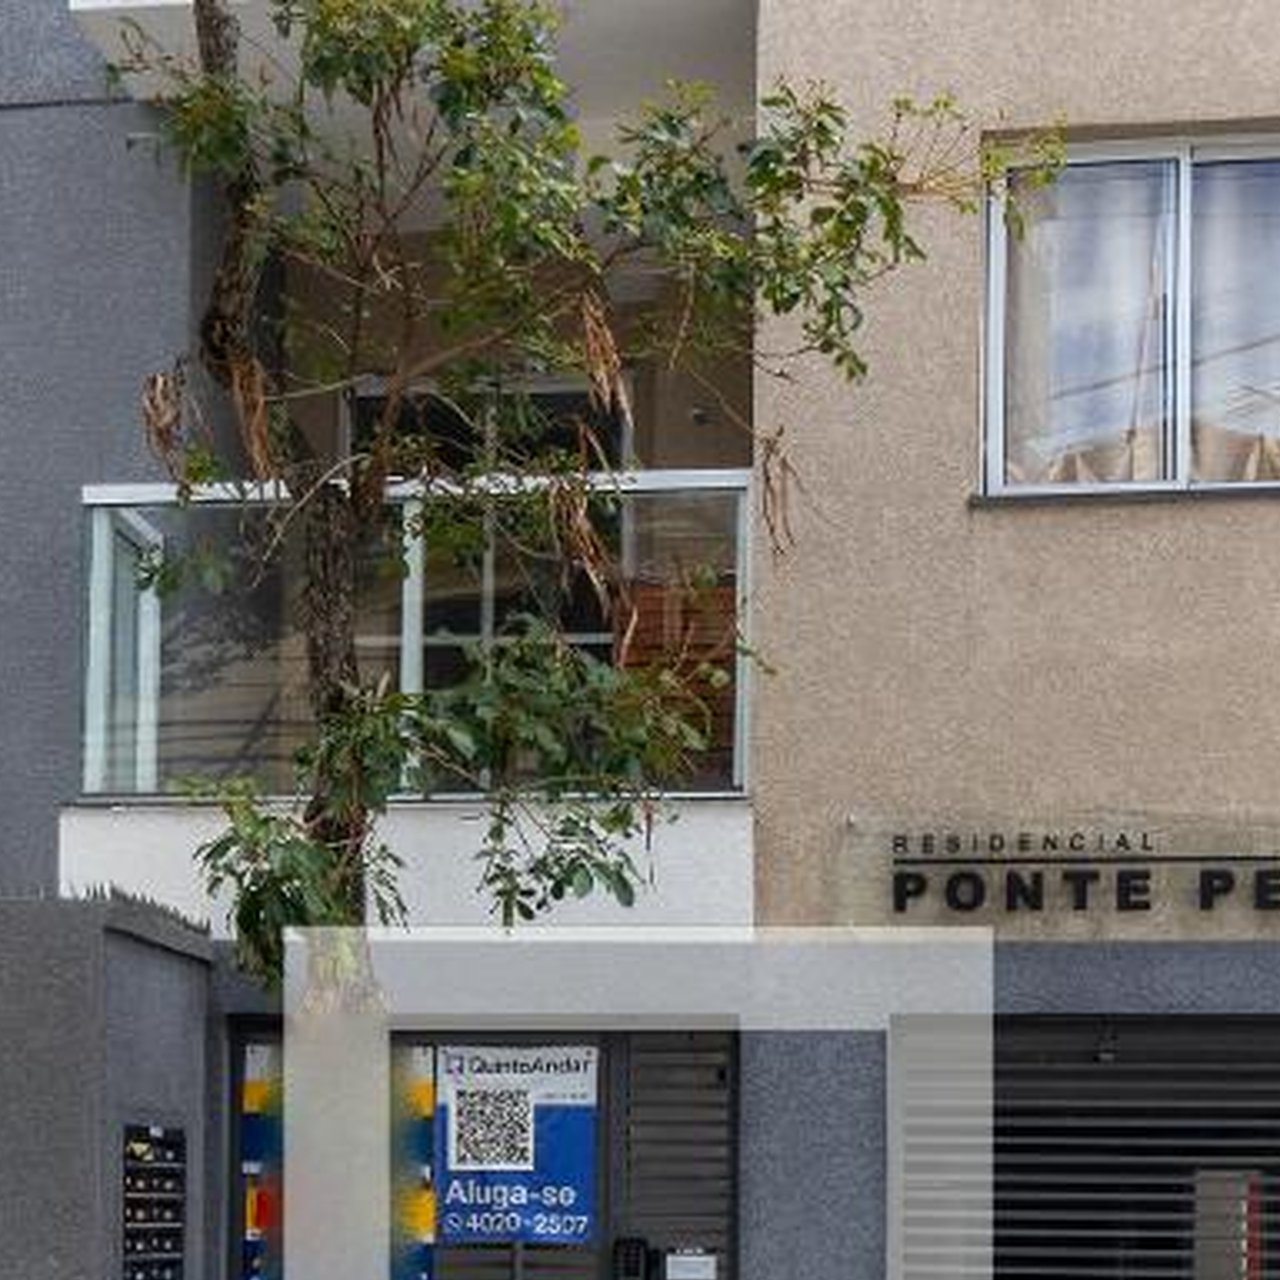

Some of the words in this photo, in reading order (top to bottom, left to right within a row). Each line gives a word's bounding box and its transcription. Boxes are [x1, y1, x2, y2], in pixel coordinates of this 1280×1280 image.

[892, 833, 1154, 853] RESIDENCIAL
[892, 869, 1152, 912] PONTE
[470, 1055, 590, 1075] QuintoAndar
[445, 1179, 577, 1211] Aluga-se
